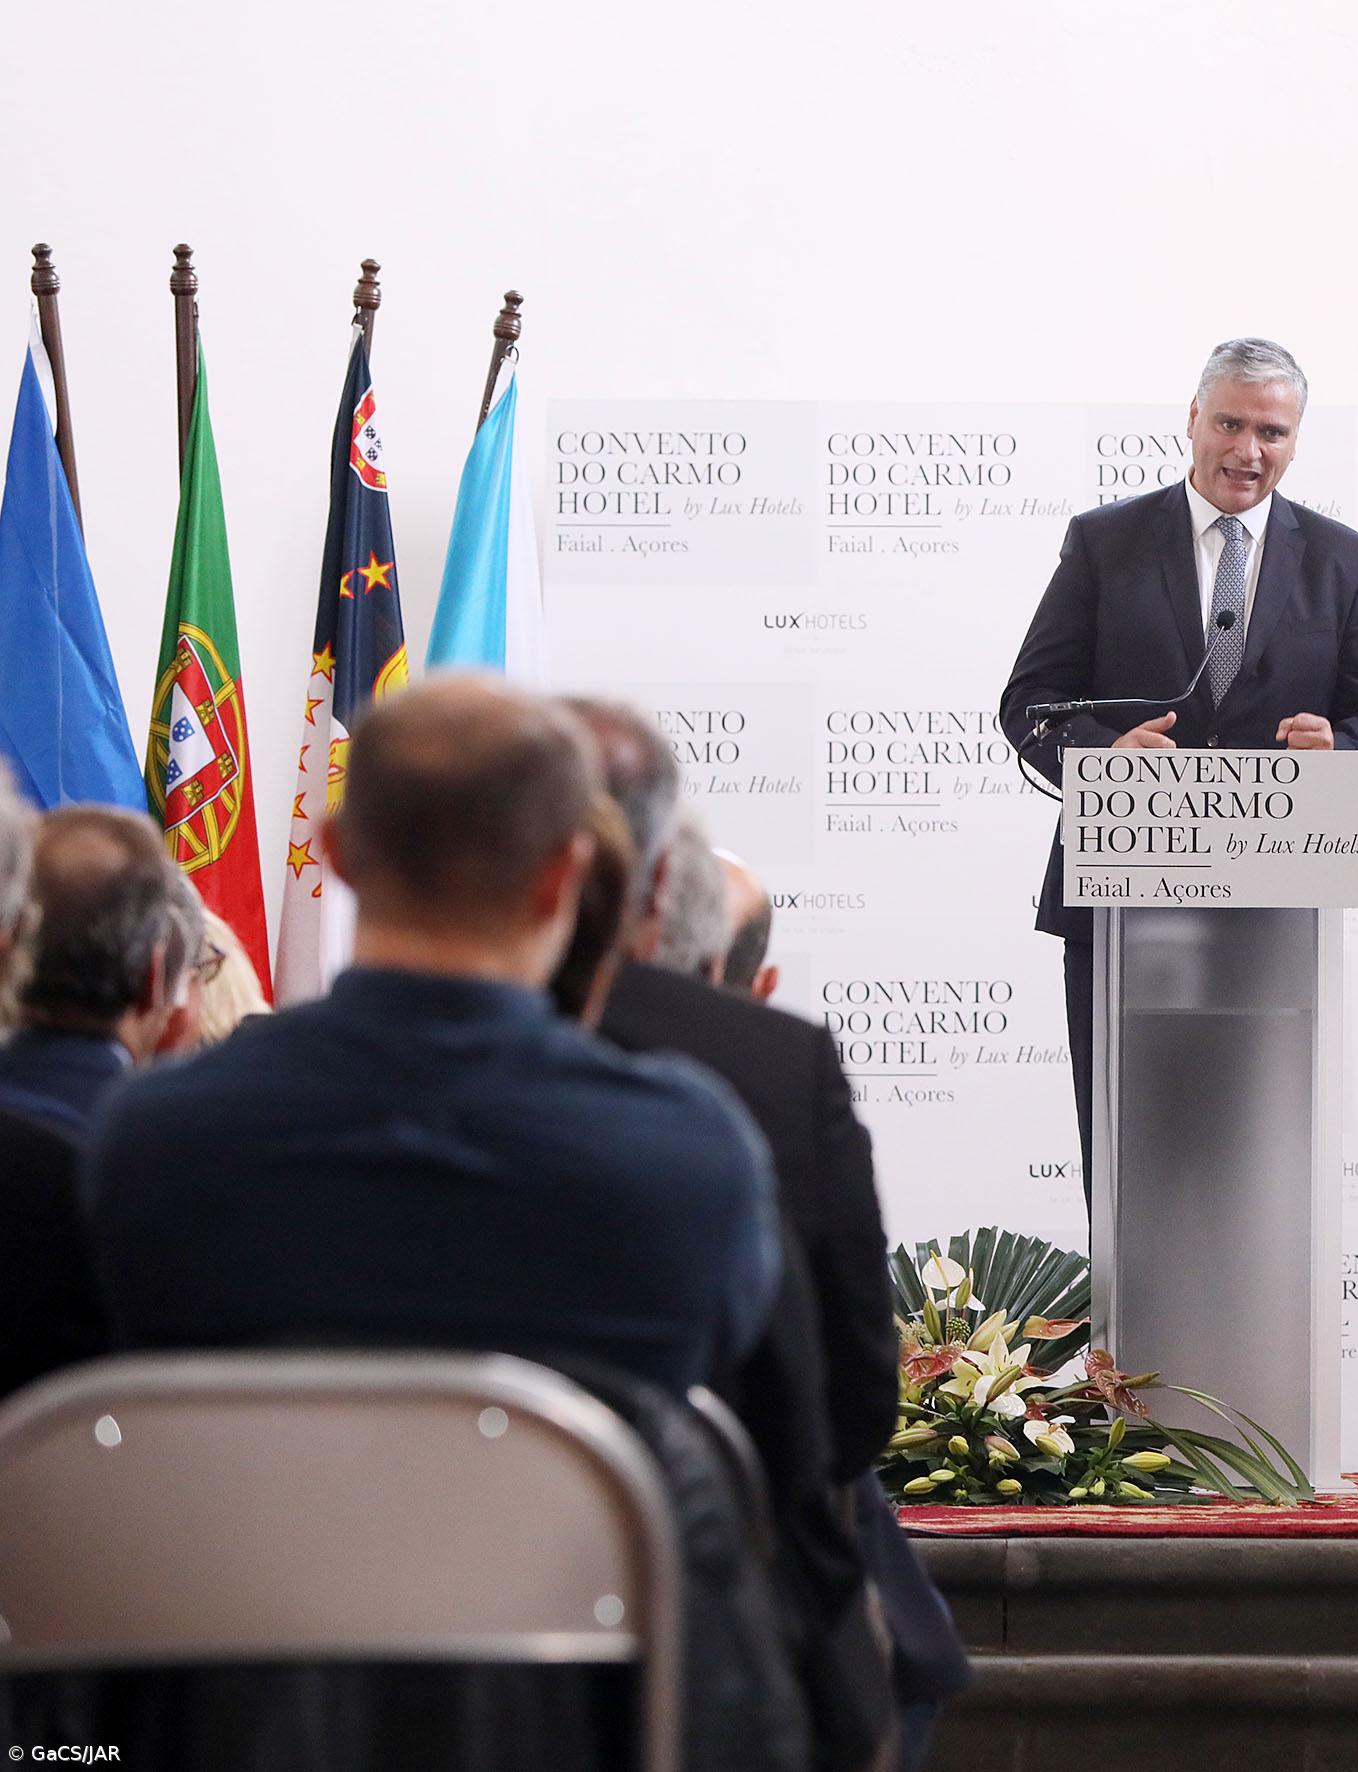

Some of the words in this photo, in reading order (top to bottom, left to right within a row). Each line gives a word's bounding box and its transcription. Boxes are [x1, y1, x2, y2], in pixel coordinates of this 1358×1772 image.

[557, 432, 746, 455] CONVENTO
[828, 434, 1016, 456] CONVENTO
[1096, 434, 1188, 457] CONV
[558, 462, 605, 484] DO
[617, 463, 740, 484] CARMO
[829, 464, 876, 485] DO
[888, 464, 1011, 485] CARMO
[1099, 465, 1145, 486] DO
[558, 492, 671, 514] HOTEL
[684, 497, 702, 520] by
[709, 497, 741, 514] Lux
[750, 497, 802, 515] Hotels
[830, 493, 941, 515] HOTEL
[955, 498, 973, 520] by
[979, 498, 1011, 515] Lux
[1020, 498, 1073, 516] Hotels
[558, 534, 602, 552] Faial
[622, 536, 688, 557] Açores
[829, 536, 872, 552] Faial
[893, 537, 959, 558] Açores
[829, 742, 875, 763] DO
[887, 740, 1010, 764] CARMO
[1078, 755, 1299, 784] CONVENTO
[707, 776, 739, 793] Lux
[748, 776, 800, 793] Hotels
[828, 772, 940, 793] HOTEL
[953, 776, 972, 800] by
[979, 776, 1010, 794] Lux
[1077, 791, 1135, 818] DO
[1148, 791, 1293, 819] CARMO
[827, 814, 871, 832] Faial
[891, 816, 958, 837] Açores
[1077, 826, 1211, 853] HOTEL
[1227, 833, 1247, 859] by
[1255, 833, 1294, 853] Lux
[1077, 877, 1130, 897] Faial
[1153, 878, 1231, 904] Açores
[823, 981, 1012, 1004] CONVENTO
[883, 1011, 1007, 1033] CARMO
[949, 1046, 968, 1069] by
[976, 1046, 1007, 1064] Lux
[1016, 1046, 1069, 1064] Hotels
[888, 1085, 954, 1106] Açores
